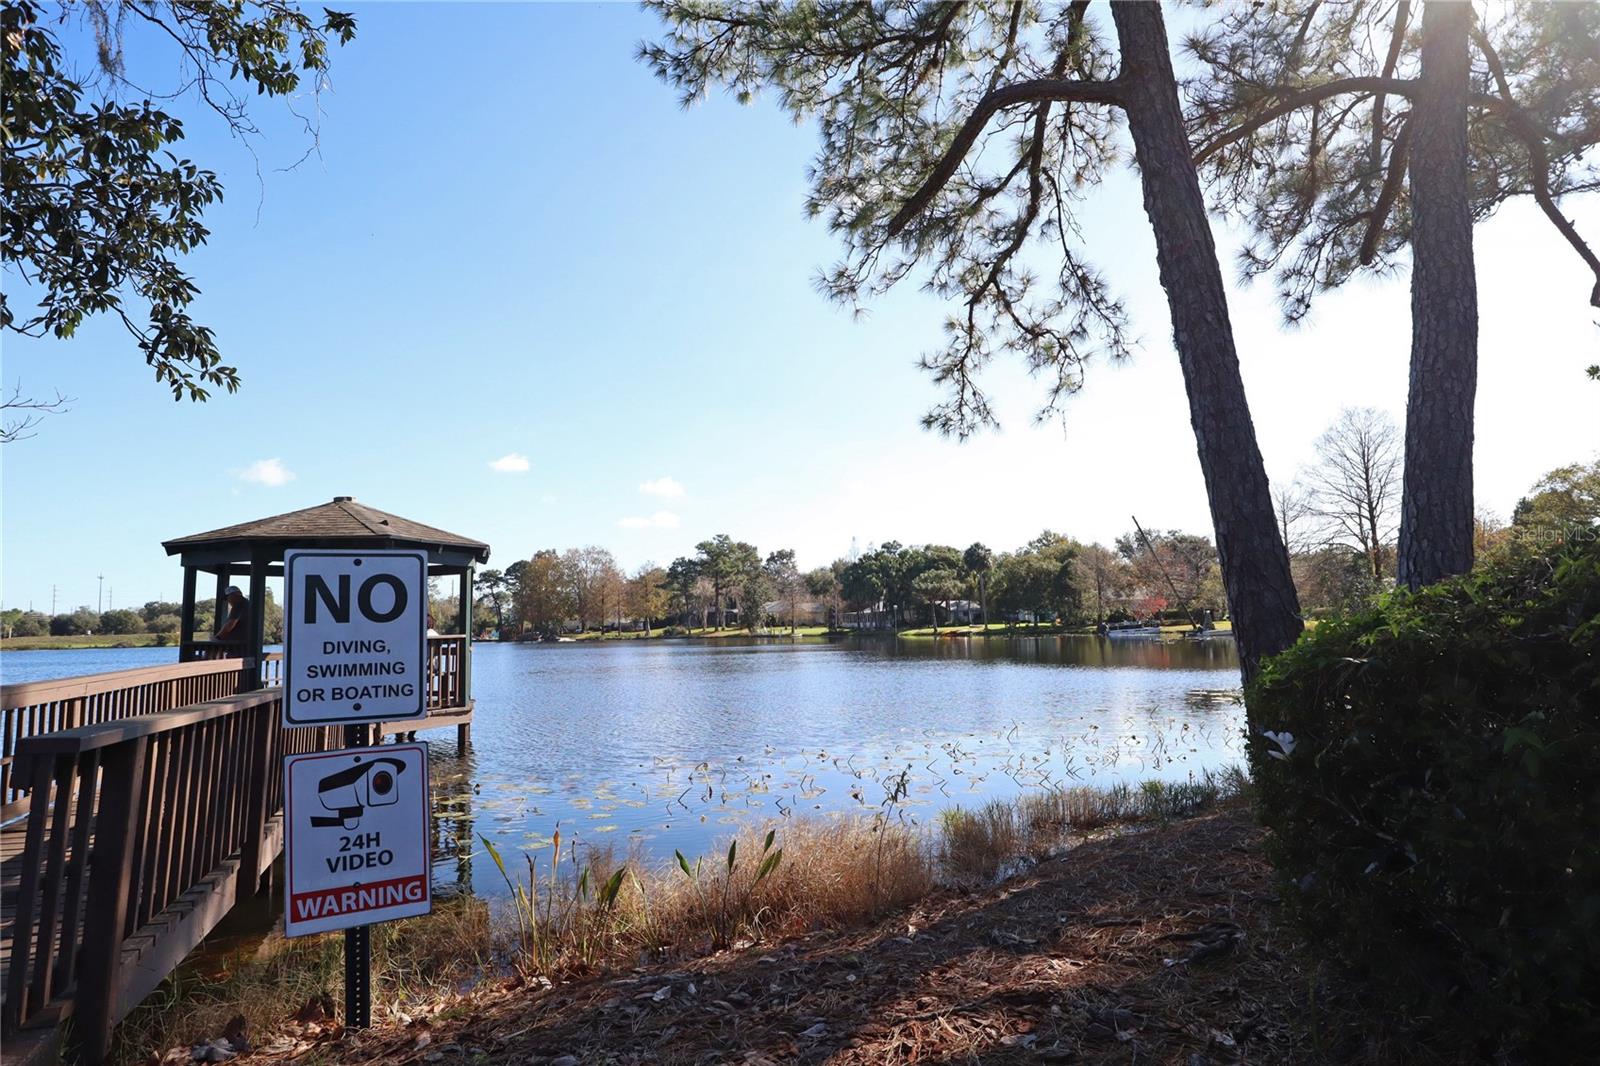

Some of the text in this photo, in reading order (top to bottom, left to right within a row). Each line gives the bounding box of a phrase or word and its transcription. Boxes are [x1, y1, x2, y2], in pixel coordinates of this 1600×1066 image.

[304, 573, 408, 624] NO
[323, 640, 391, 655] DIVING,
[306, 662, 405, 679] SWIMMING
[296, 683, 414, 703] OR BOATING
[339, 831, 380, 852] 24H
[326, 849, 393, 873] VIDEO
[296, 880, 422, 919] WARNING
